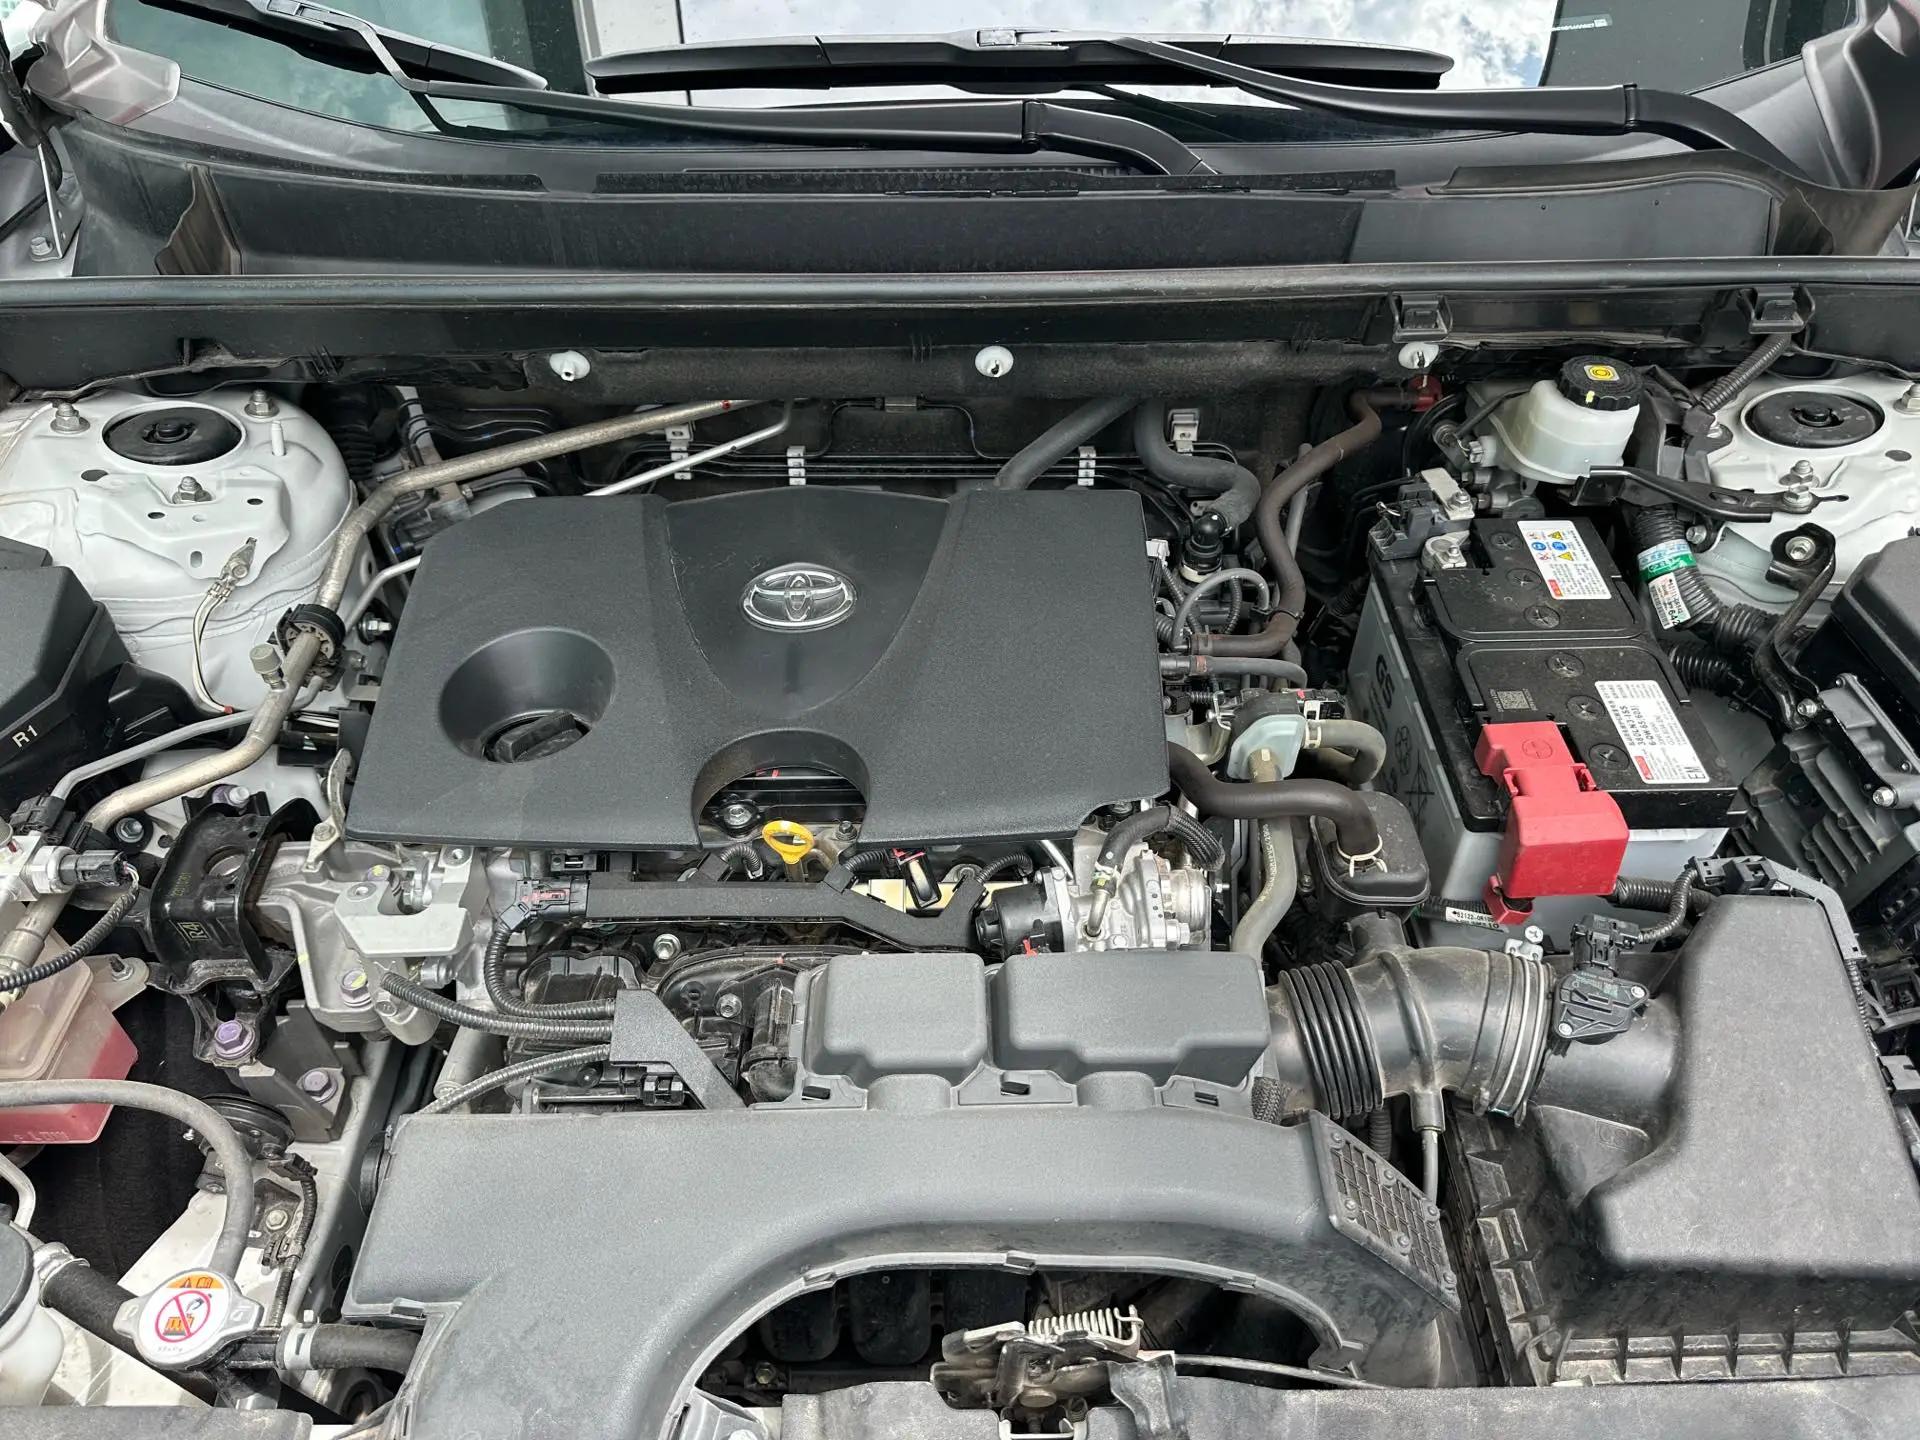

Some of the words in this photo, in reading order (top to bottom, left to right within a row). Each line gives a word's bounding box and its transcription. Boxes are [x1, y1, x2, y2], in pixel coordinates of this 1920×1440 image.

[1376, 653, 1395, 709] GS
[12, 724, 38, 748] R1
[182, 923, 209, 939] R4
